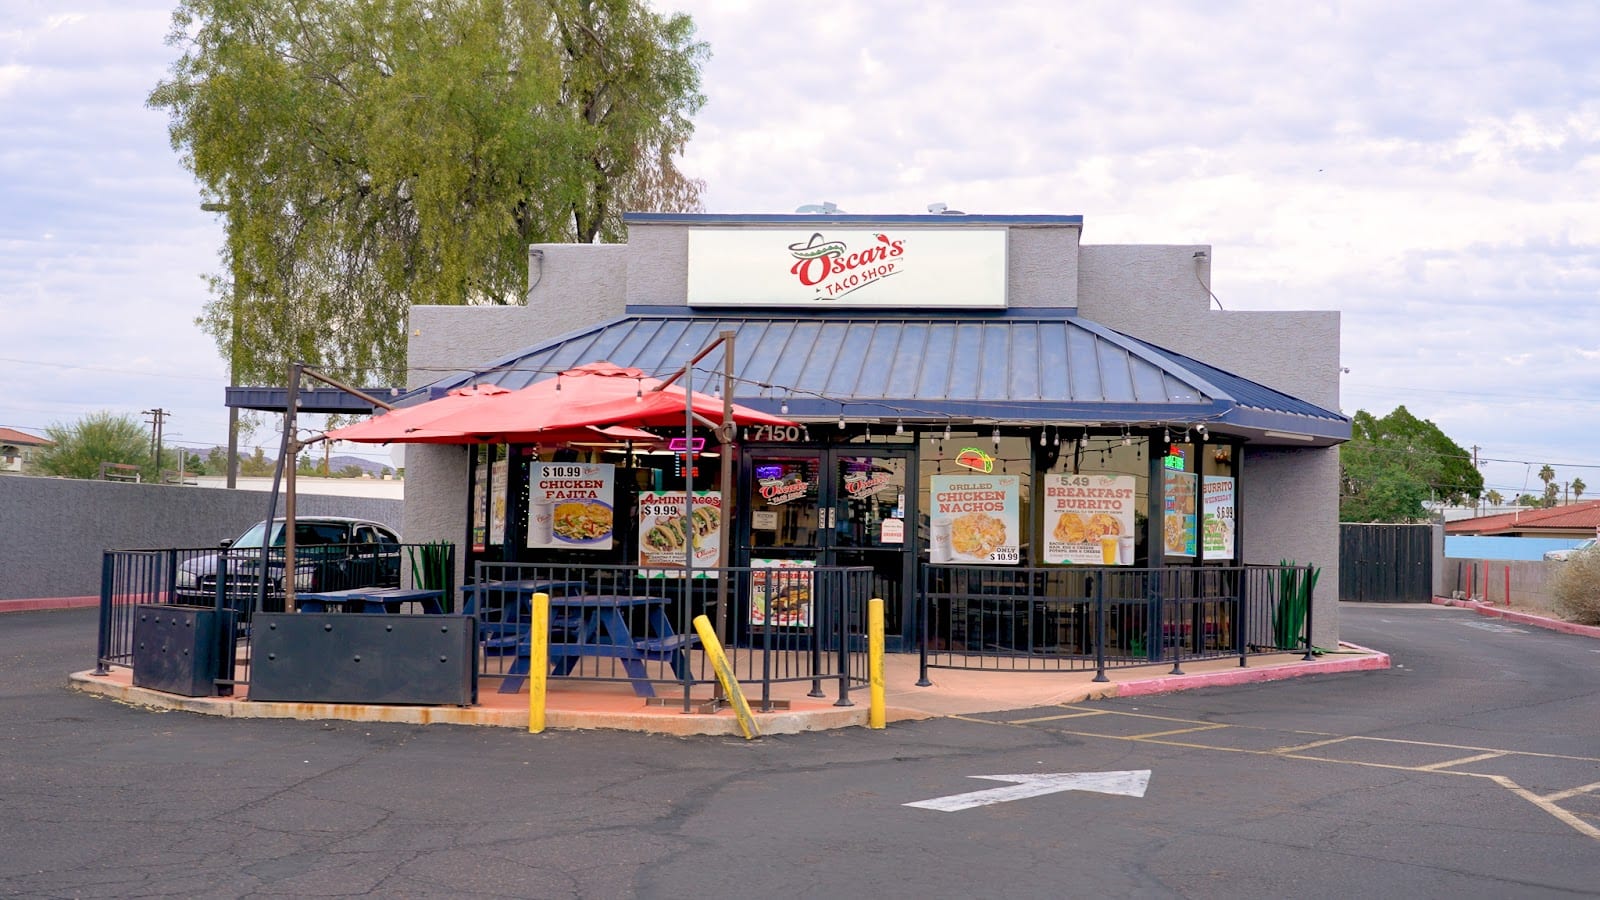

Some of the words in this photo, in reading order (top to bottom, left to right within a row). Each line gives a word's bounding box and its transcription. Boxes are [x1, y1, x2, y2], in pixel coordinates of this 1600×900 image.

[790, 233, 904, 286] Oscar's
[825, 274, 859, 297] TACO
[861, 262, 895, 282] SHOP
[753, 424, 800, 442] 7150
[539, 480, 604, 489] CHICKEN
[949, 483, 993, 491] GRILLED
[1202, 480, 1233, 495] BURRITO
[546, 490, 598, 499] FAJITA
[936, 490, 1006, 502] CHICKEN
[1047, 487, 1133, 499] BREAKFAST
[659, 496, 684, 505] MINI
[685, 496, 719, 505] ACOS
[1056, 499, 1123, 510] BURRITO
[939, 501, 1004, 513] NACHOS
